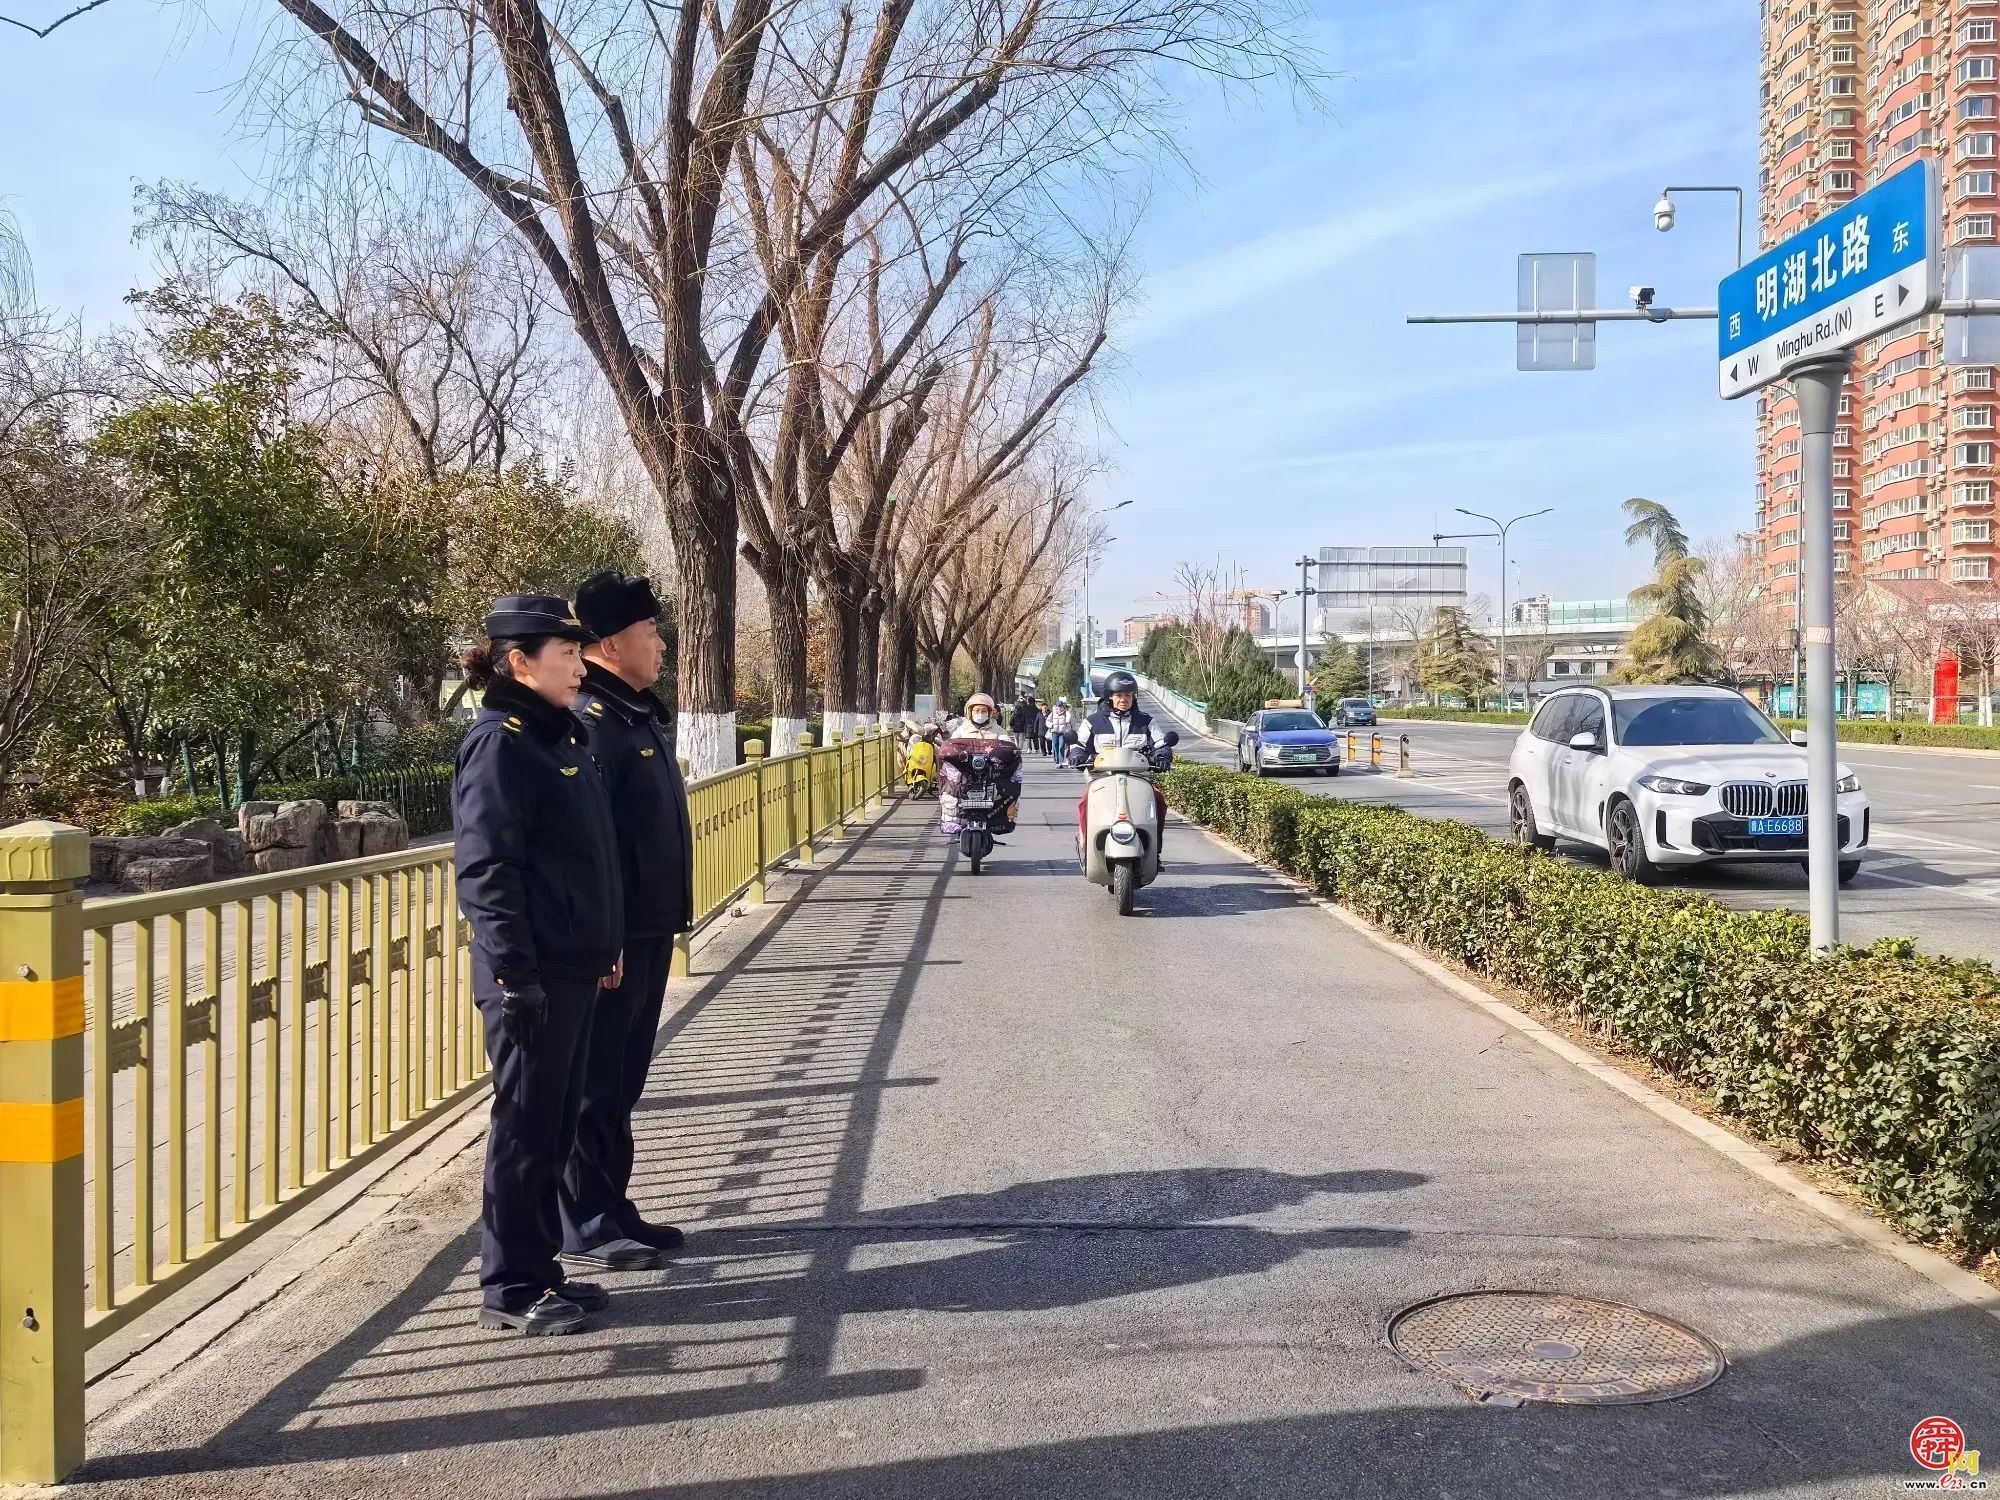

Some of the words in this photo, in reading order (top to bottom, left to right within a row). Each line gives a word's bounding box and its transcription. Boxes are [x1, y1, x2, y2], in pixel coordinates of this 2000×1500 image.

[1892, 221, 1909, 254] 东
[1756, 213, 1871, 322] 明湖北路
[1874, 293, 1884, 318] E
[1729, 311, 1741, 340] 西
[1776, 331, 1813, 361] Minghu
[1815, 307, 1852, 343] Rd.(N)
[1748, 354, 1759, 377] W
